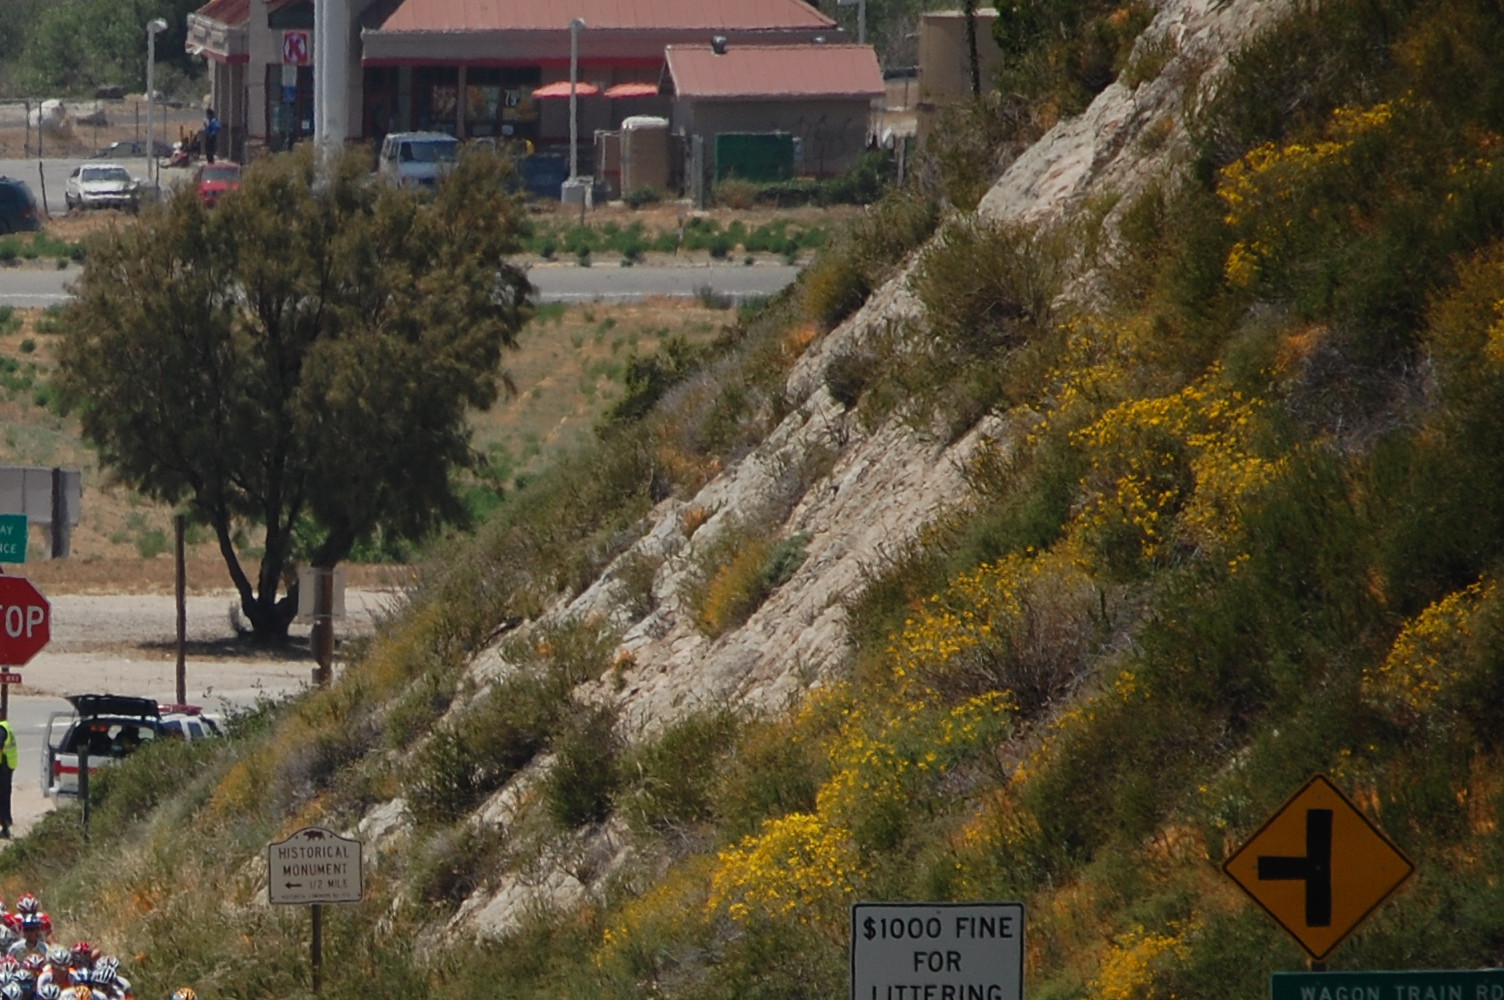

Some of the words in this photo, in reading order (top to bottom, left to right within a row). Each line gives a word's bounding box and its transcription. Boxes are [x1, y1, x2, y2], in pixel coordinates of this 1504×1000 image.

[278, 846, 350, 860] HISTORICAL
[283, 863, 348, 877] MONUMENT
[327, 879, 348, 889] MILE
[863, 916, 942, 941] $1000
[956, 916, 1014, 939] FINE
[914, 951, 962, 973] FOR
